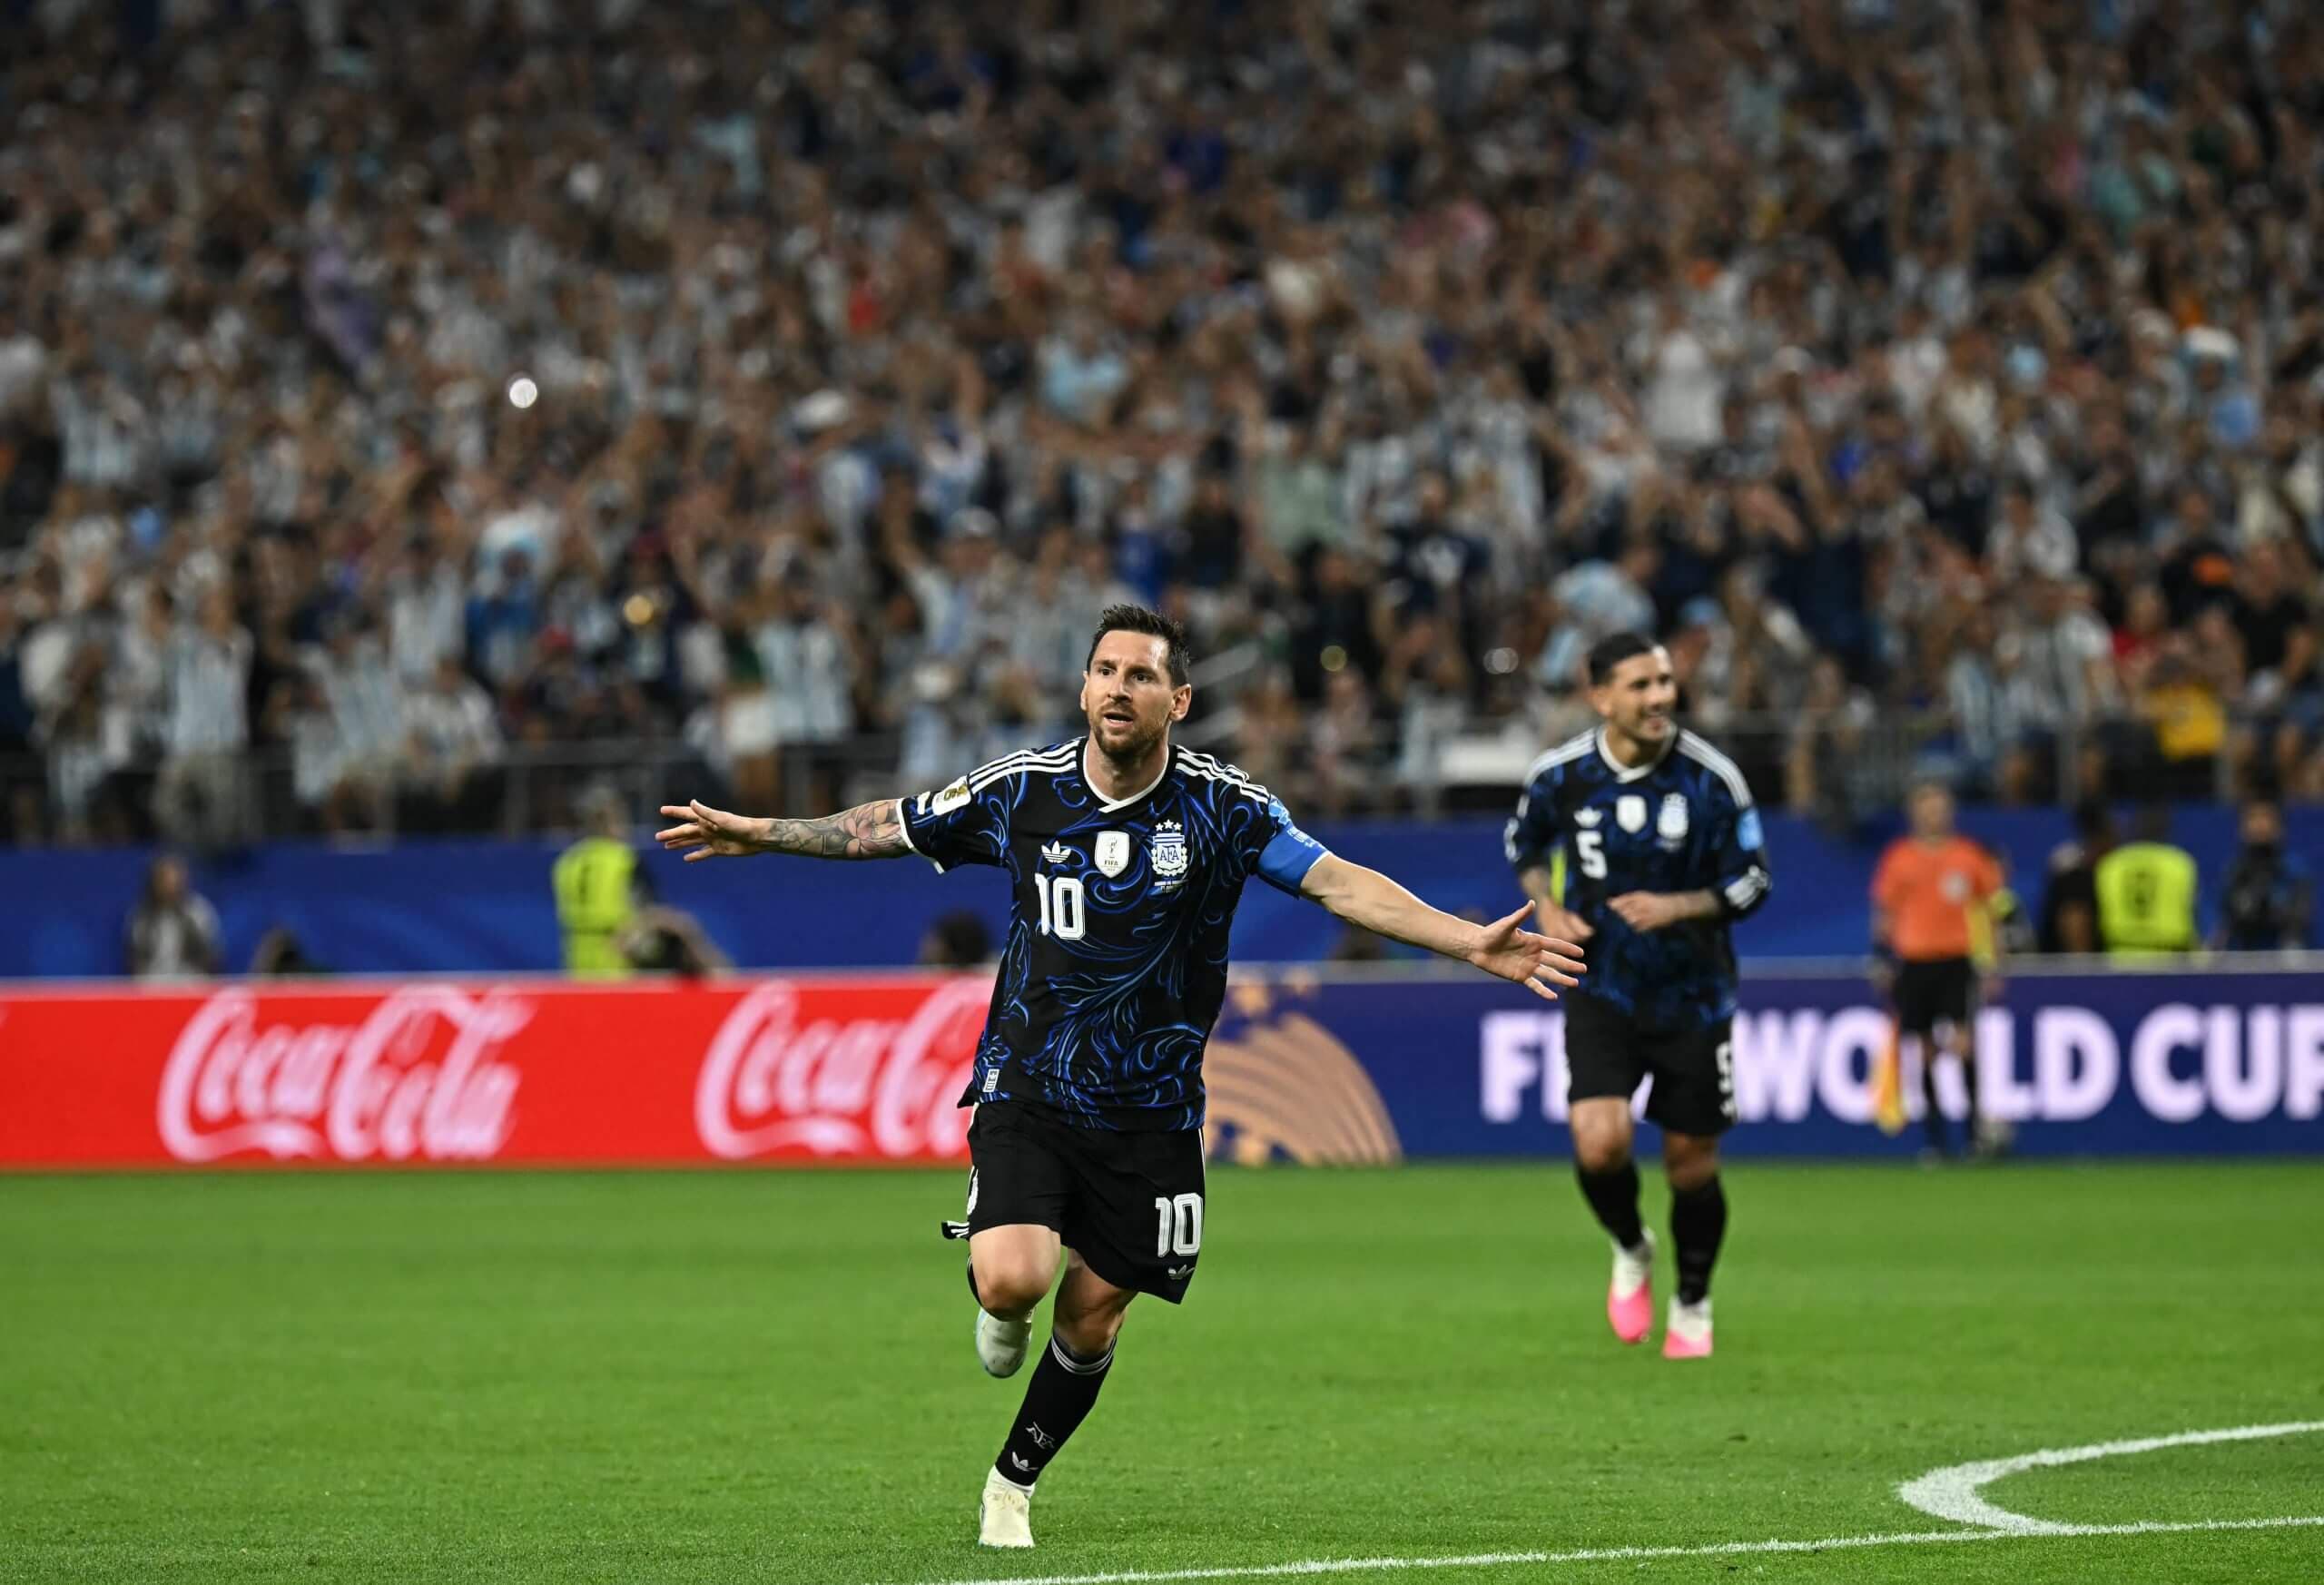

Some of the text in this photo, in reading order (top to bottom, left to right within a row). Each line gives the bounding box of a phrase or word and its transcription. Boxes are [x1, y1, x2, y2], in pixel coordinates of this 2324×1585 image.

[1159, 844, 1179, 864] AFA
[1576, 830, 1608, 880] 5
[1035, 872, 1086, 940] 10
[694, 979, 997, 1160] Coca-Co
[2130, 1001, 2324, 1123] CUP
[1155, 1192, 1203, 1258] 10
